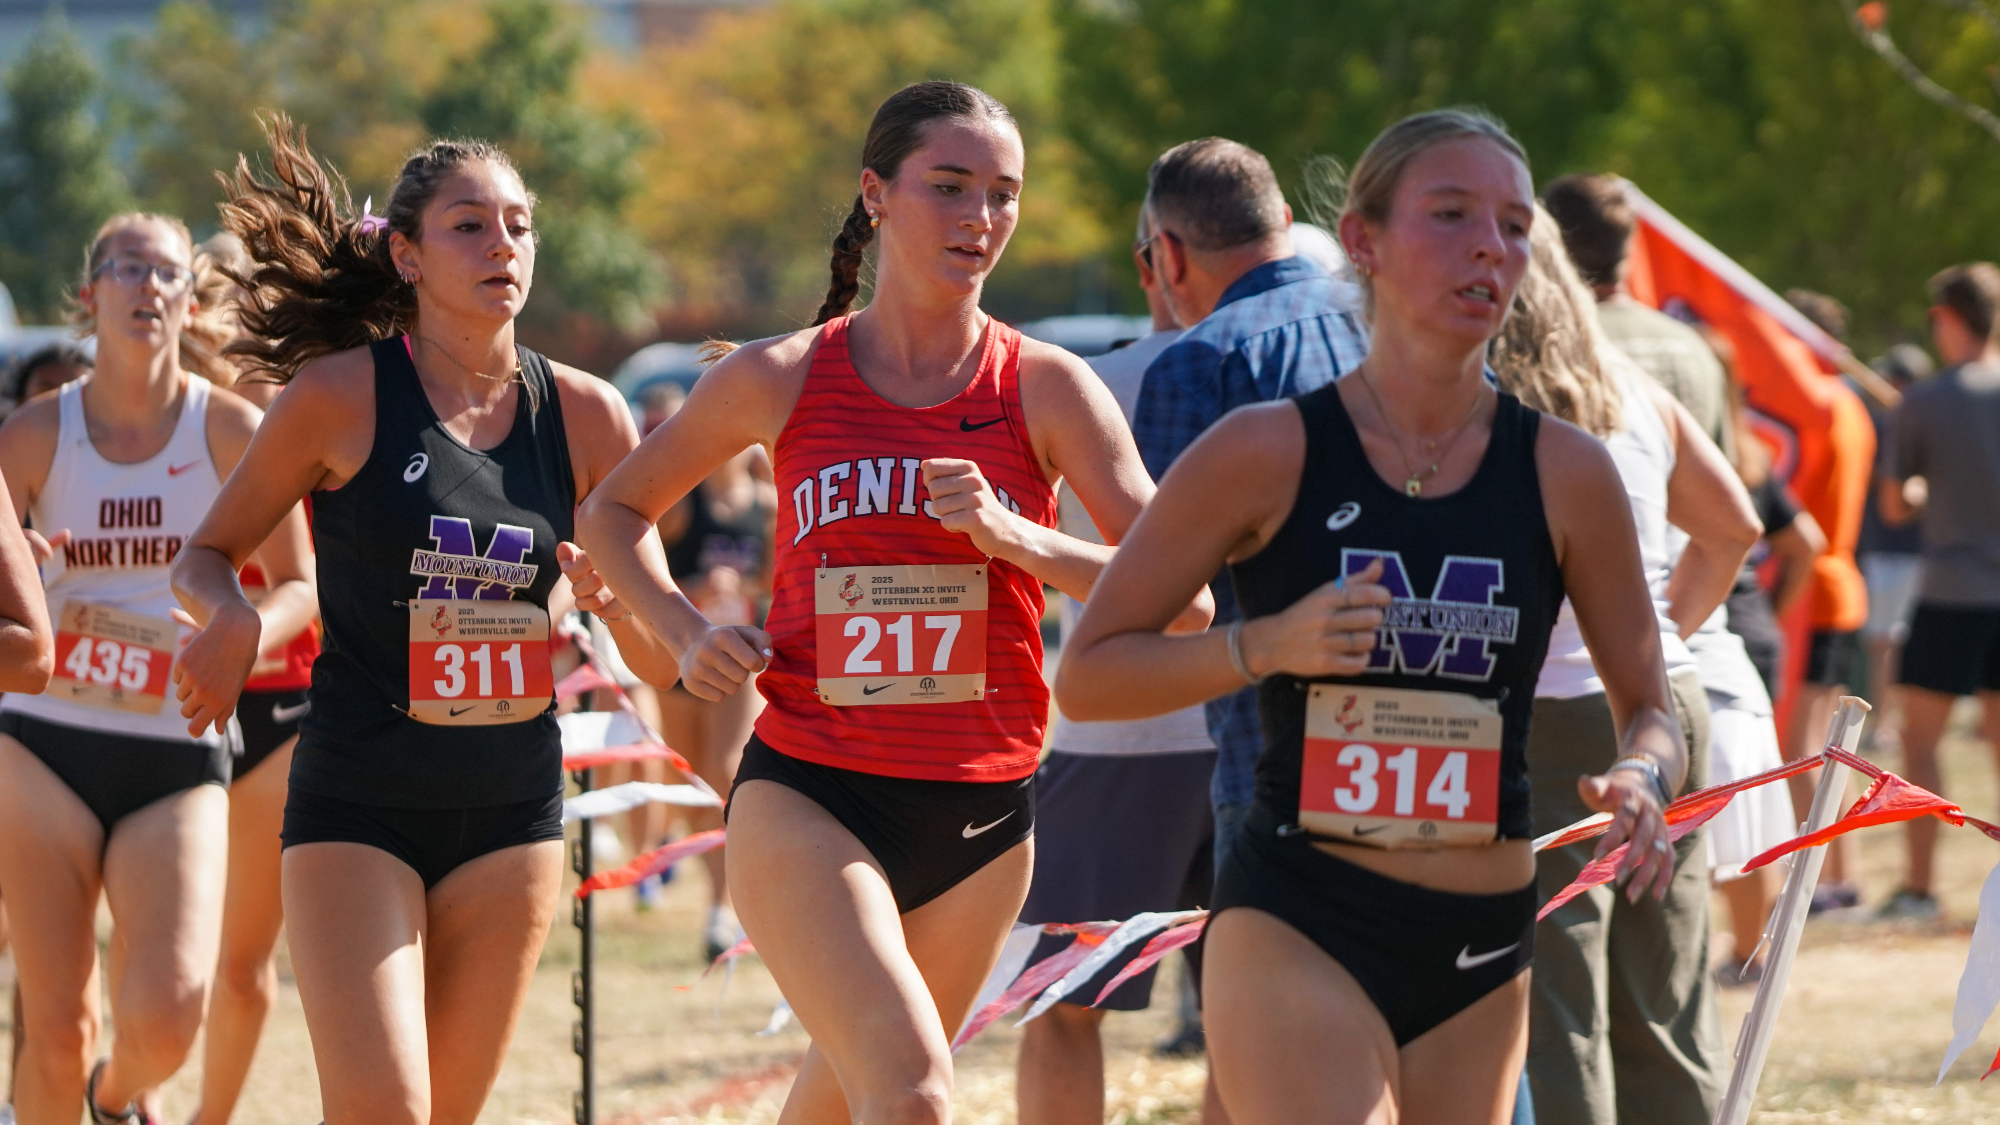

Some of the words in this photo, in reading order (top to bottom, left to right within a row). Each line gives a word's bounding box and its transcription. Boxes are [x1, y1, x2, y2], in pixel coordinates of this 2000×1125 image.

[98, 495, 163, 529] OHIO
[793, 457, 1021, 548] DENI
[63, 534, 190, 568] NORTHER
[415, 553, 480, 576] MOUNT
[479, 562, 535, 584] UNION
[871, 576, 894, 584] 2025
[871, 586, 920, 595] OTTERBEIN
[921, 586, 935, 594] XC
[937, 585, 967, 593] INVITE
[871, 597, 938, 606] WESTERVILLE,
[939, 596, 959, 604] OHIO
[458, 617, 496, 625] OTTERBEIN
[508, 617, 532, 625] INVITE
[1429, 606, 1516, 637] UNION
[843, 614, 962, 674] 217
[65, 636, 151, 692] 435
[433, 643, 525, 698] 311
[1333, 743, 1471, 819] 314
